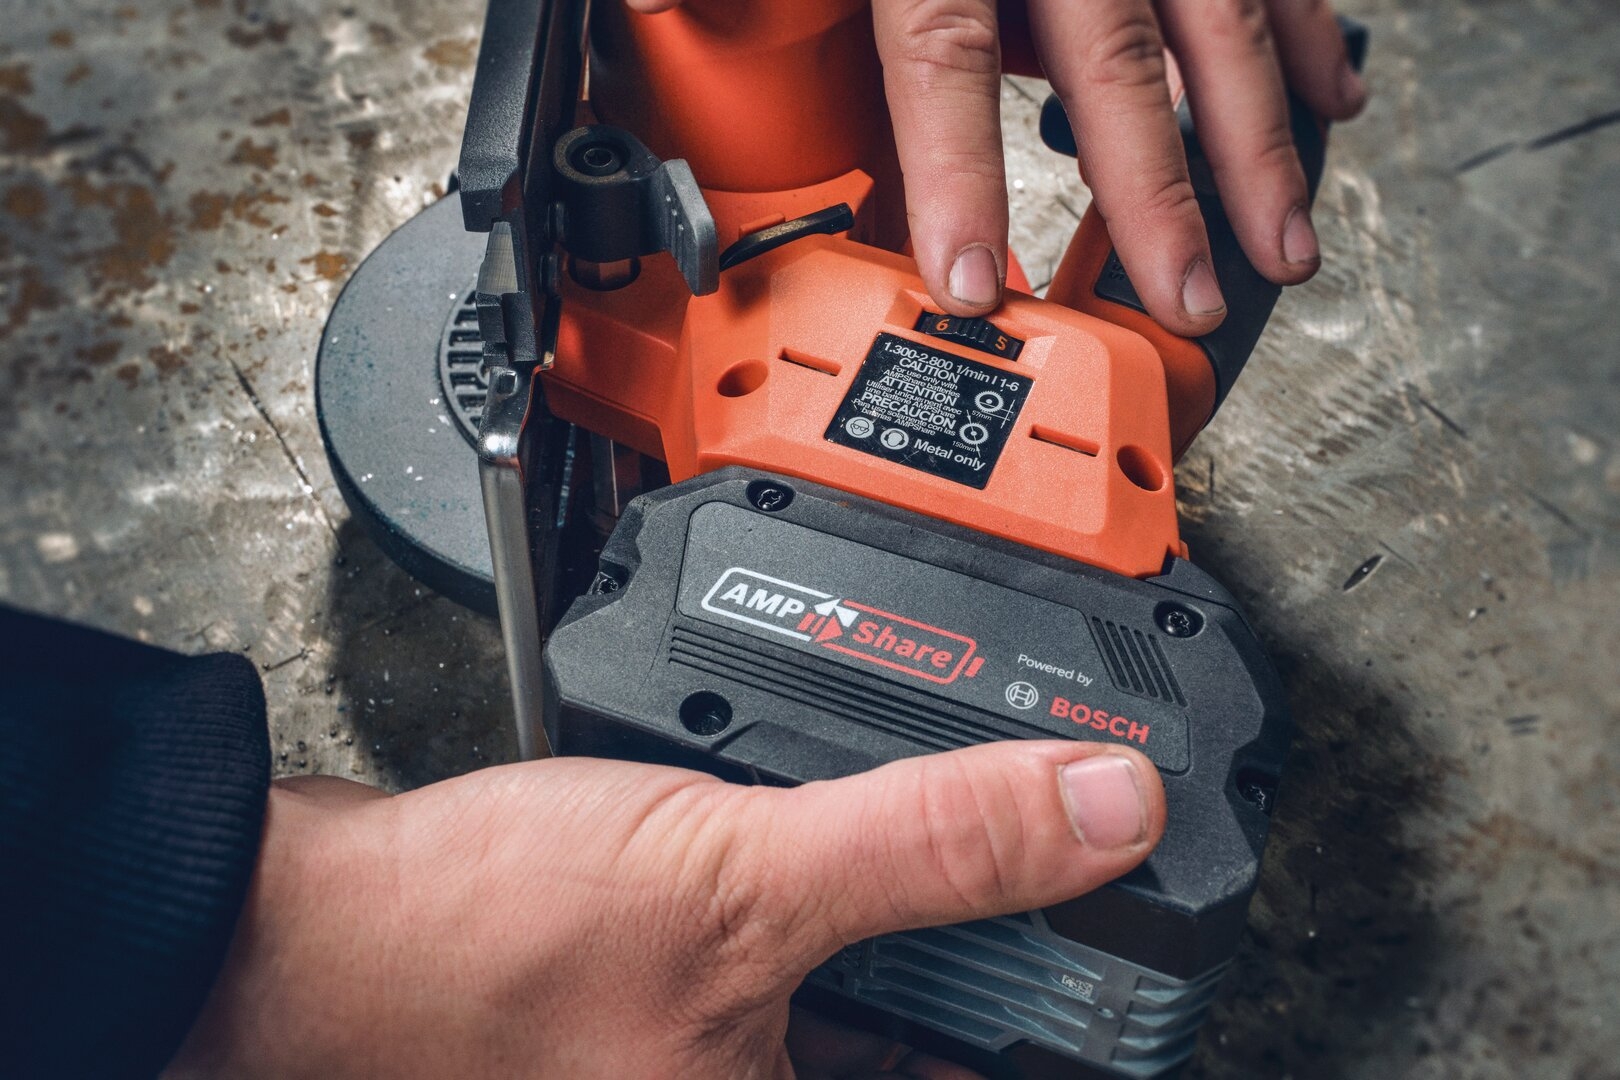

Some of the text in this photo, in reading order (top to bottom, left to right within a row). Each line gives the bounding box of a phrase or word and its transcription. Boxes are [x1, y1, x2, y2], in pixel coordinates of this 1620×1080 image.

[936, 318, 951, 332] 6
[995, 335, 1008, 351] 5
[883, 369, 961, 398] AMPShare batteries
[884, 342, 954, 371] 1.300-2.800
[956, 364, 990, 384] 1/min
[1000, 378, 1020, 392] 1-6
[892, 365, 958, 390] For use only with
[899, 357, 961, 384] CAUTION
[865, 386, 882, 395] une
[911, 401, 956, 419] AMPShare
[866, 379, 963, 415] Utiliser uniquement avec
[879, 375, 958, 407] ATTENTION
[853, 398, 871, 409] Para
[871, 405, 886, 414] uso
[927, 422, 943, 431] con
[943, 428, 956, 437] las
[893, 418, 936, 436] AMPShare
[913, 438, 986, 471] Metal only
[952, 440, 976, 453] 150mm
[719, 582, 806, 619] AMP
[852, 620, 954, 669] Share
[1017, 653, 1094, 687] Powered by
[1049, 696, 1150, 744] BOSCH
